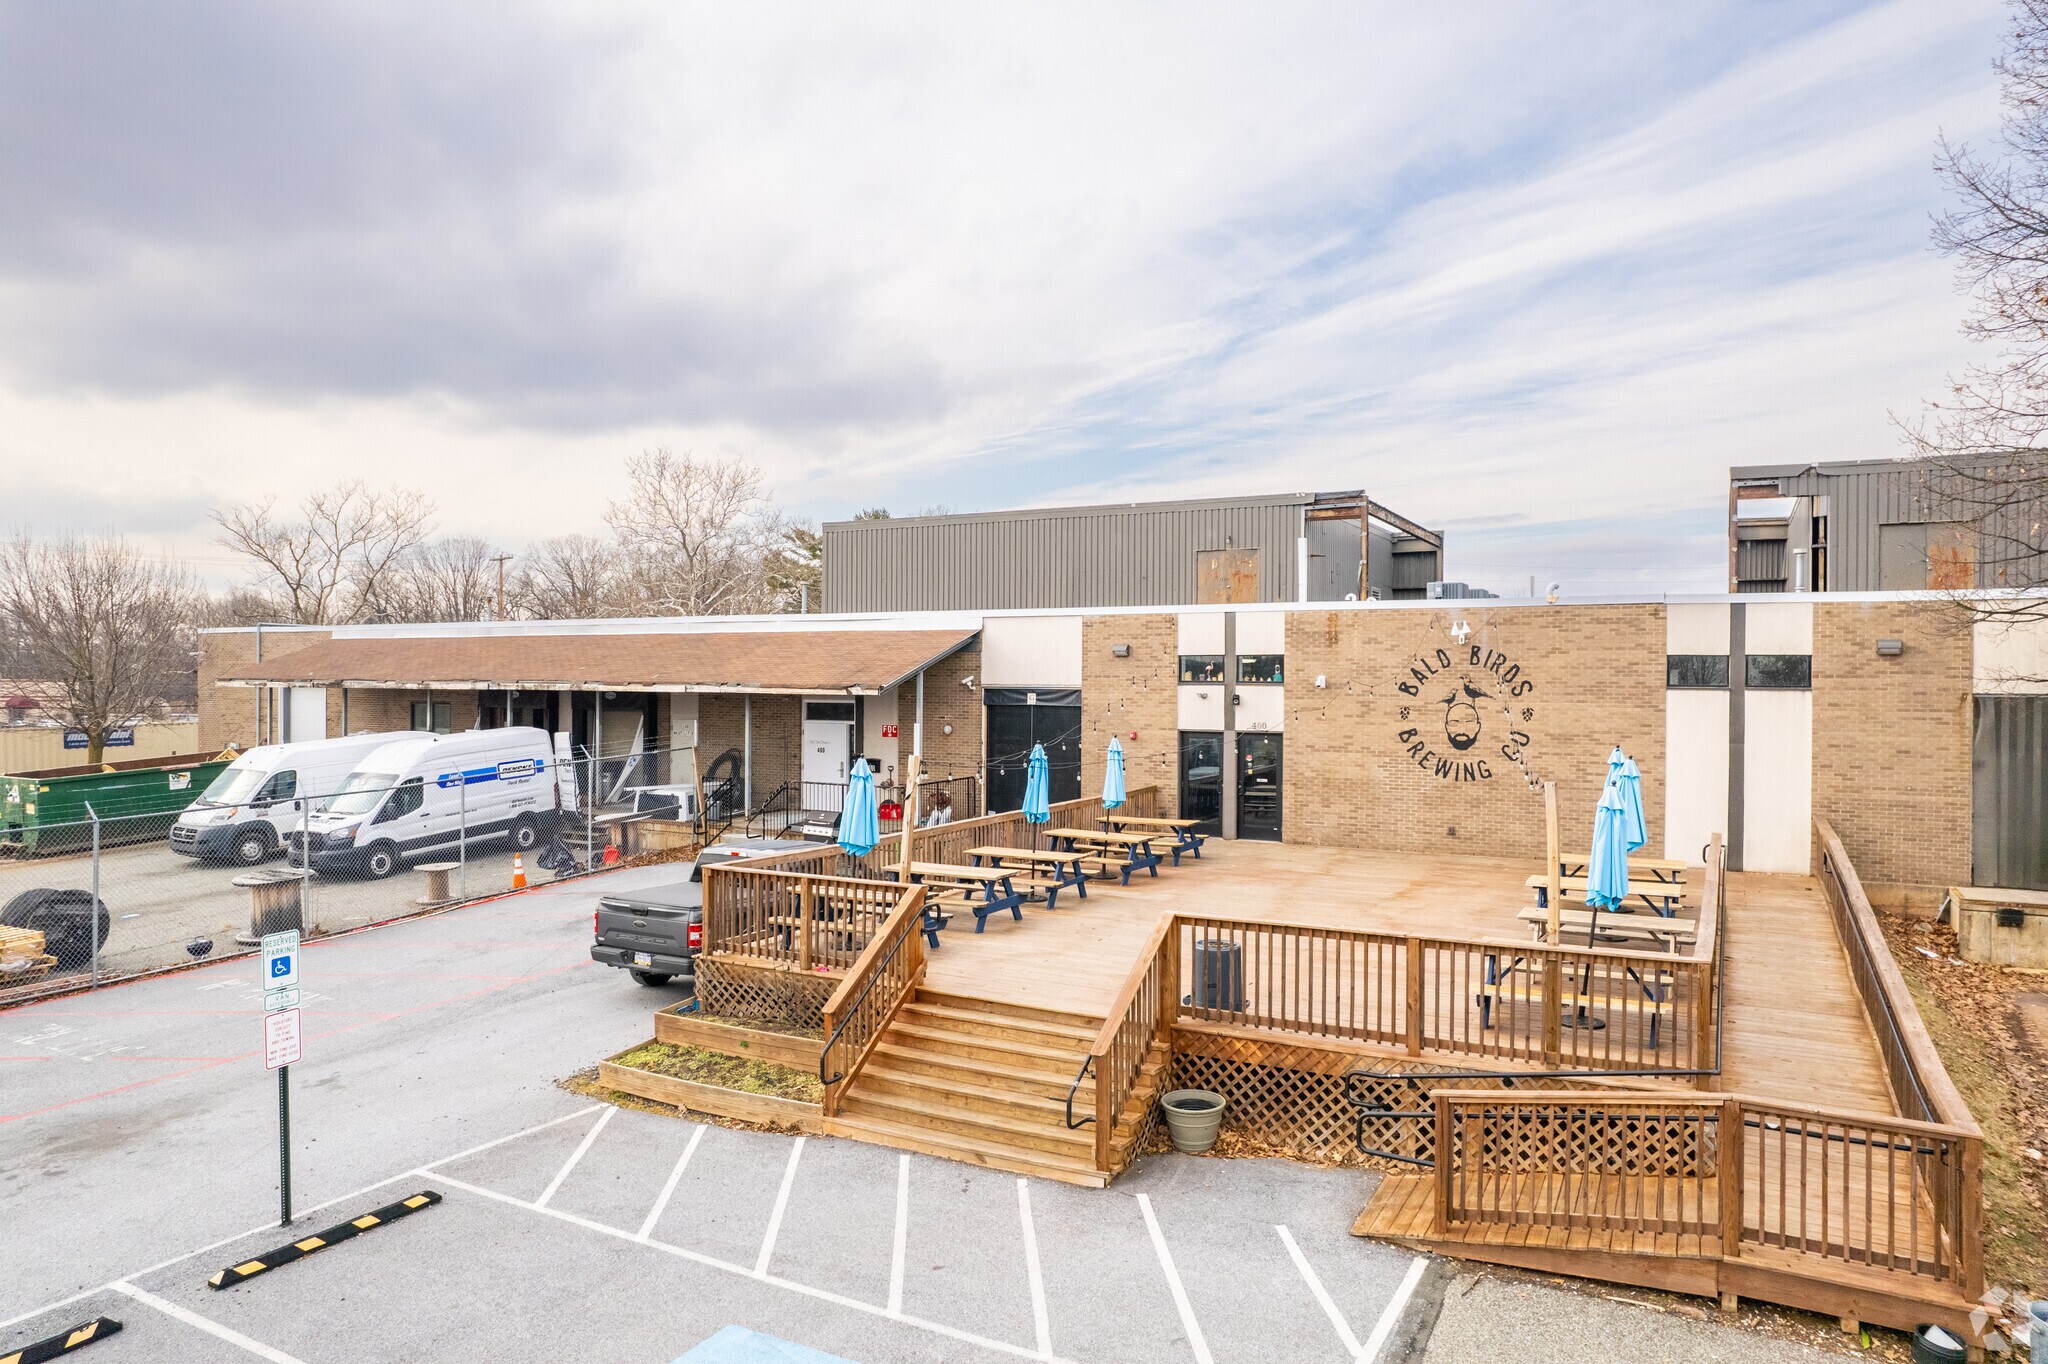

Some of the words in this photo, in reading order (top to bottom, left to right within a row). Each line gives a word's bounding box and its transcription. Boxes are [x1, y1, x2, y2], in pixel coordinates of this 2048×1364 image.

[1398, 648, 1451, 697] BALD
[1470, 645, 1533, 697] BIRDS
[882, 725, 897, 733] FDC
[1398, 728, 1493, 782] BREWING
[1501, 730, 1531, 762] CO
[265, 935, 296, 949] RESERVED
[266, 945, 296, 958] PARKING
